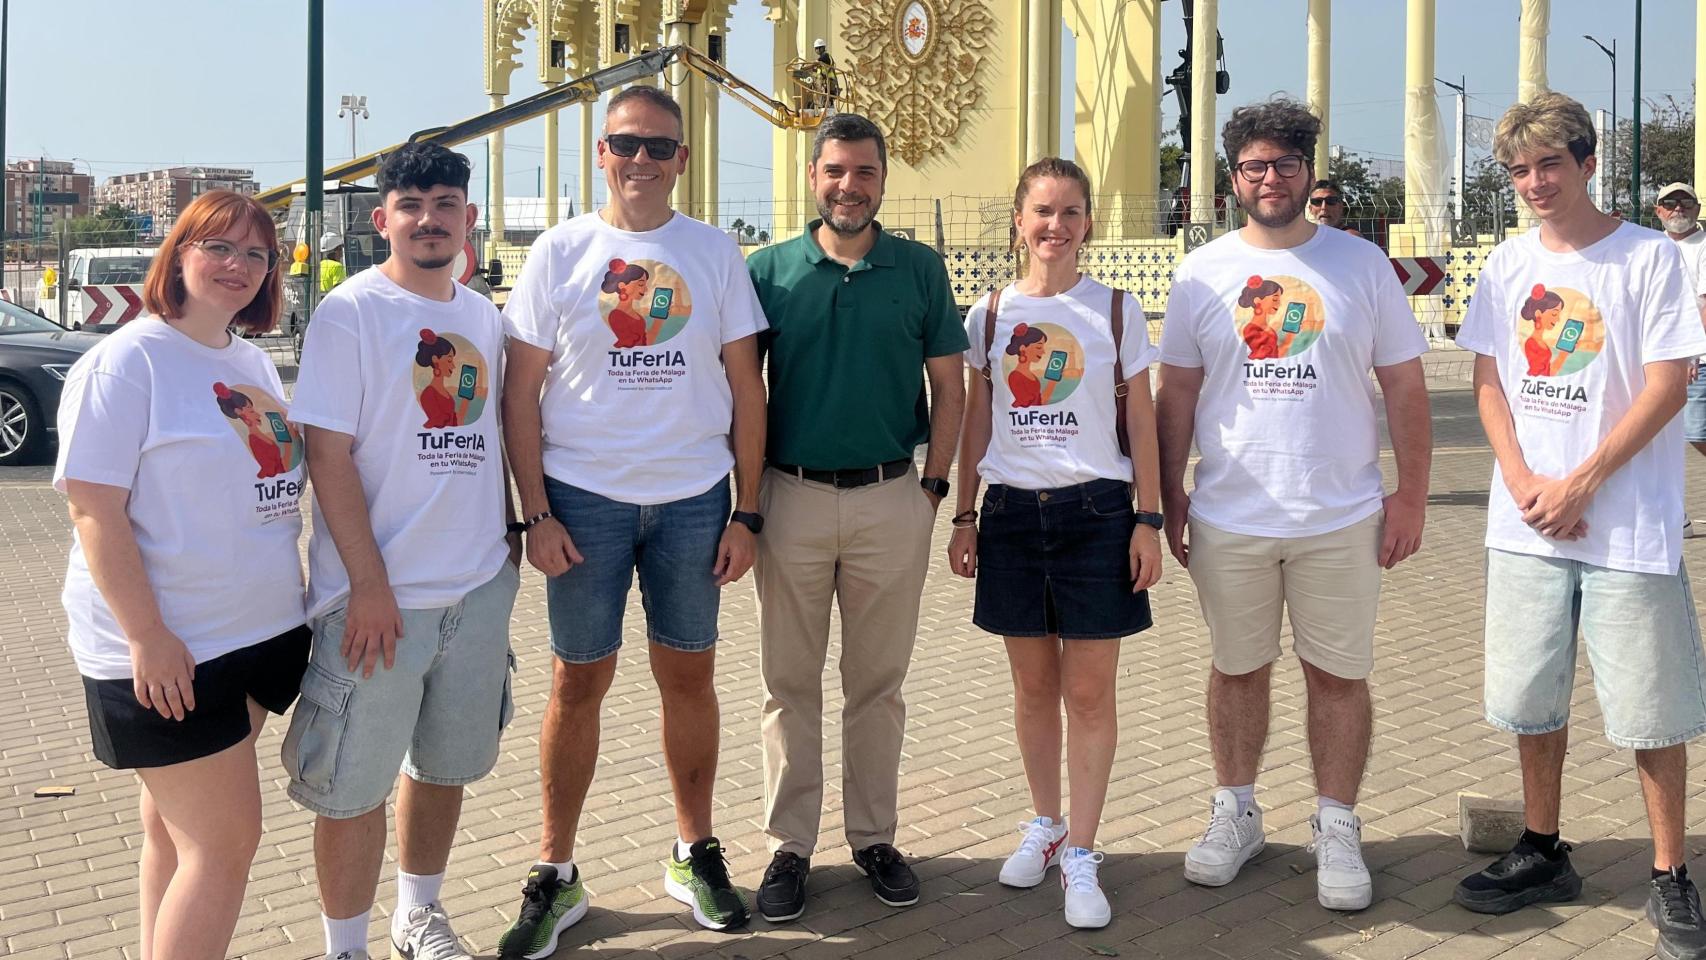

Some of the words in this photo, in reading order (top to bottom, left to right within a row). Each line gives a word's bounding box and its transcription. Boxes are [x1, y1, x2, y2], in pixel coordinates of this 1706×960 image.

[608, 351, 686, 367] TuFerIA
[661, 369, 685, 377] Málaga
[1243, 363, 1317, 380] TuFerIA
[1292, 381, 1317, 389] Málaga
[1521, 379, 1588, 402] TuFerIA
[1560, 402, 1587, 412] Málaga
[1008, 411, 1079, 426] TuFerIA
[1056, 428, 1079, 436] Málaga
[417, 432, 485, 451] TuFerIA
